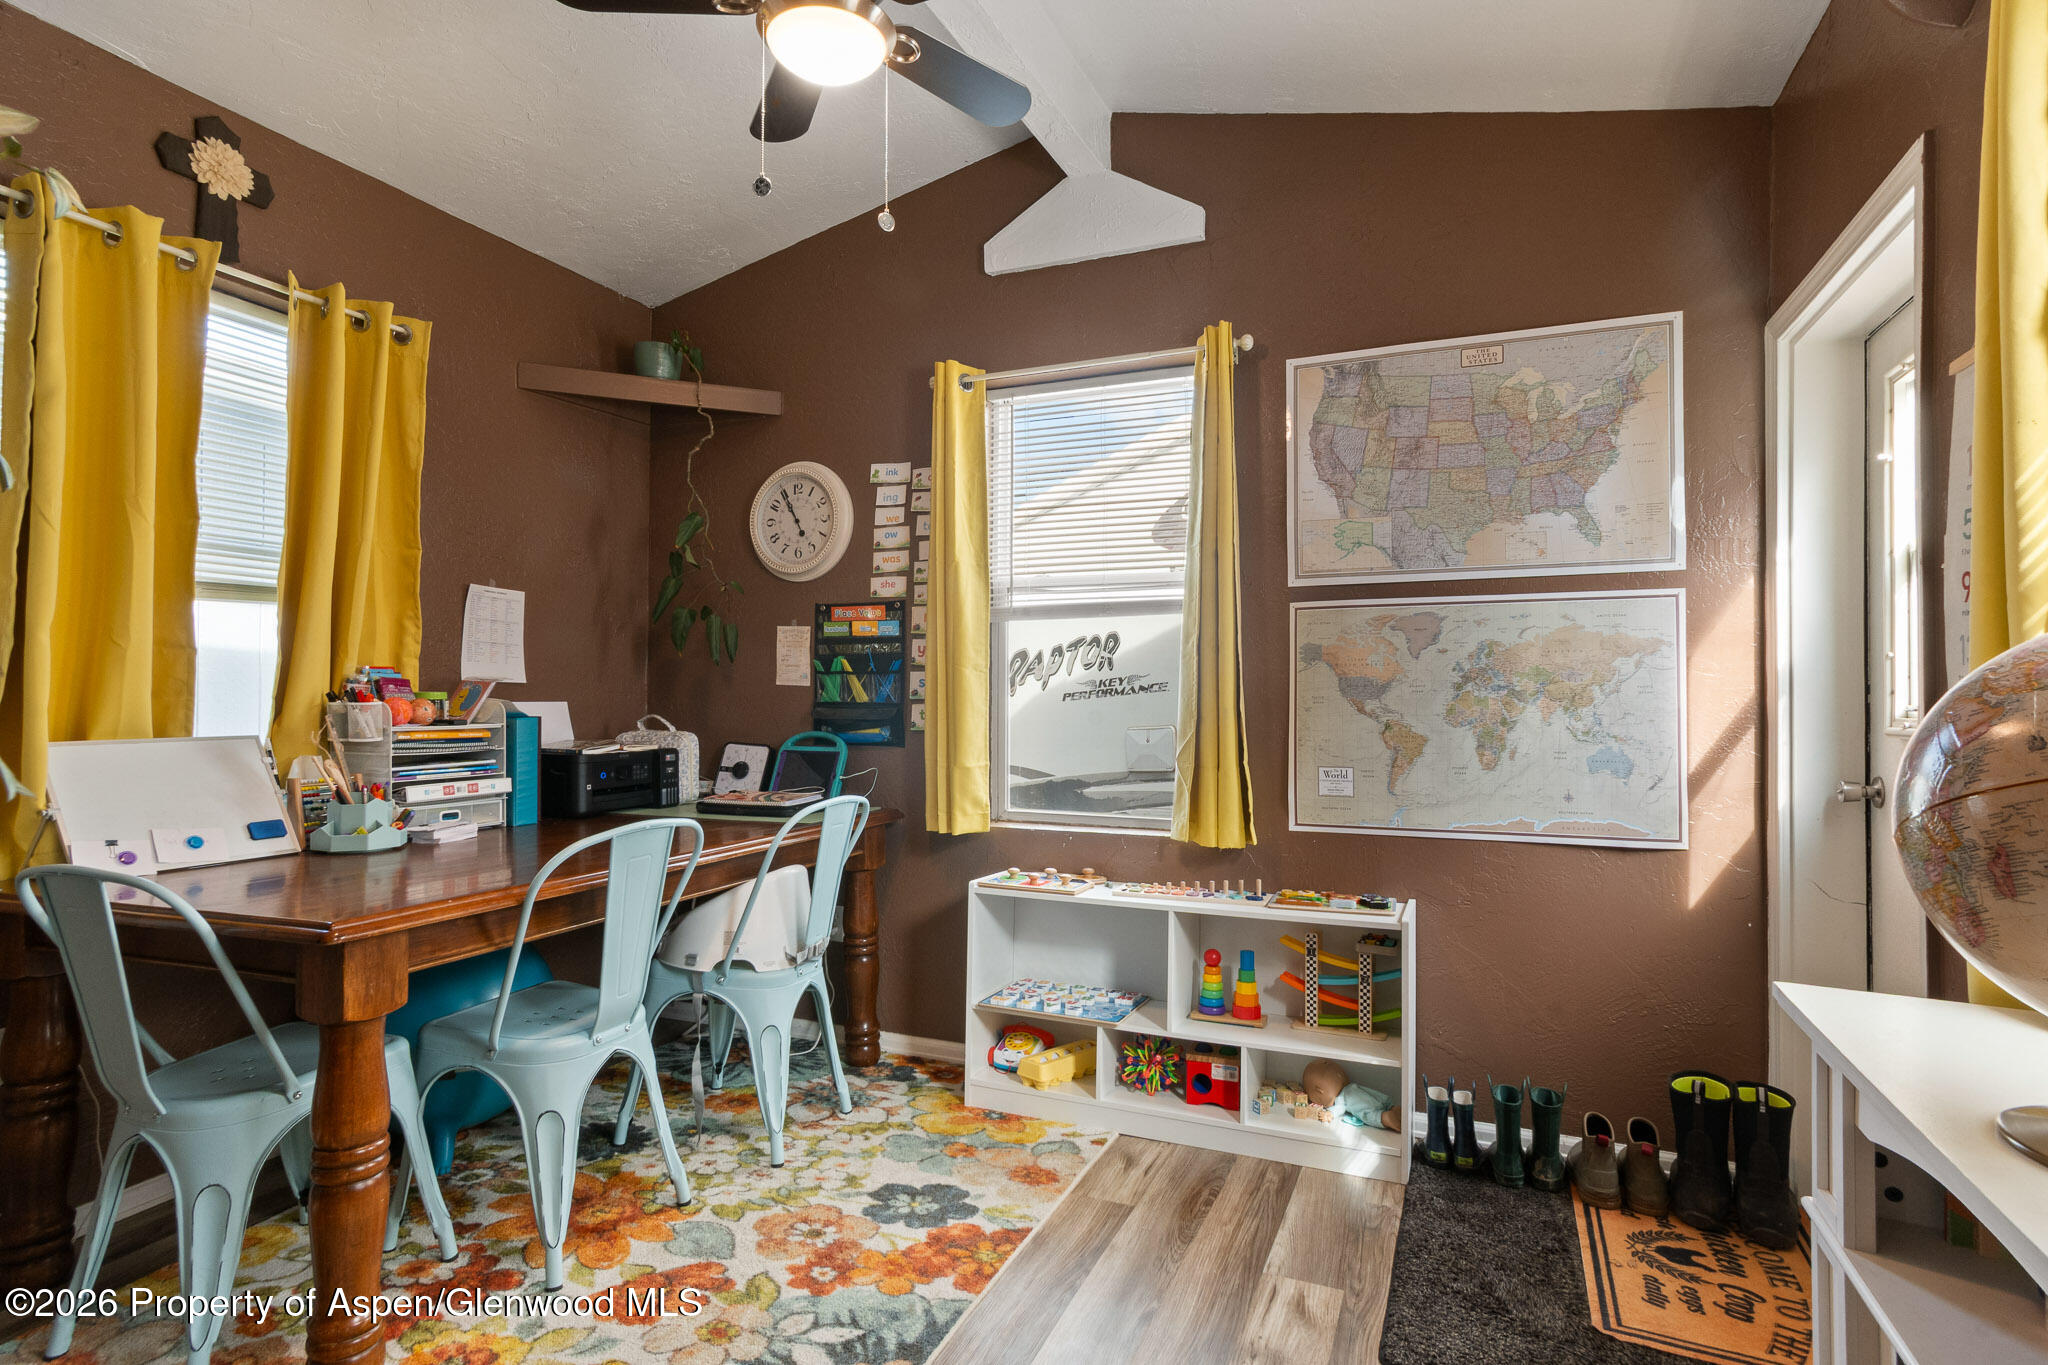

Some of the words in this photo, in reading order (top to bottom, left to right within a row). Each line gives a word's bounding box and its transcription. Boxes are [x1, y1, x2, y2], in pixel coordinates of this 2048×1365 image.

[886, 468, 898, 476] ink
[793, 483, 804, 496] 12
[808, 486, 815, 496] 1
[816, 496, 826, 508] 2
[882, 493, 898, 504] ing
[770, 500, 781, 512] 10
[766, 518, 776, 528] 9
[770, 533, 780, 544] 8
[781, 543, 790, 554] 7
[794, 547, 802, 559] 6
[808, 542, 816, 554] 5
[880, 580, 896, 588] she
[1962, 571, 1970, 602] 9
[834, 608, 857, 618] Place
[1008, 630, 1120, 697] RAPTOR
[1098, 676, 1128, 688] KEY
[1062, 682, 1170, 702] PERFORMANCE
[1324, 769, 1348, 779] World
[1701, 1229, 1749, 1279] hicken
[1641, 1274, 1672, 1310] daily
[1676, 1284, 1706, 1316] eggs
[1712, 1282, 1768, 1324] Coop
[1773, 1294, 1812, 1322] TO
